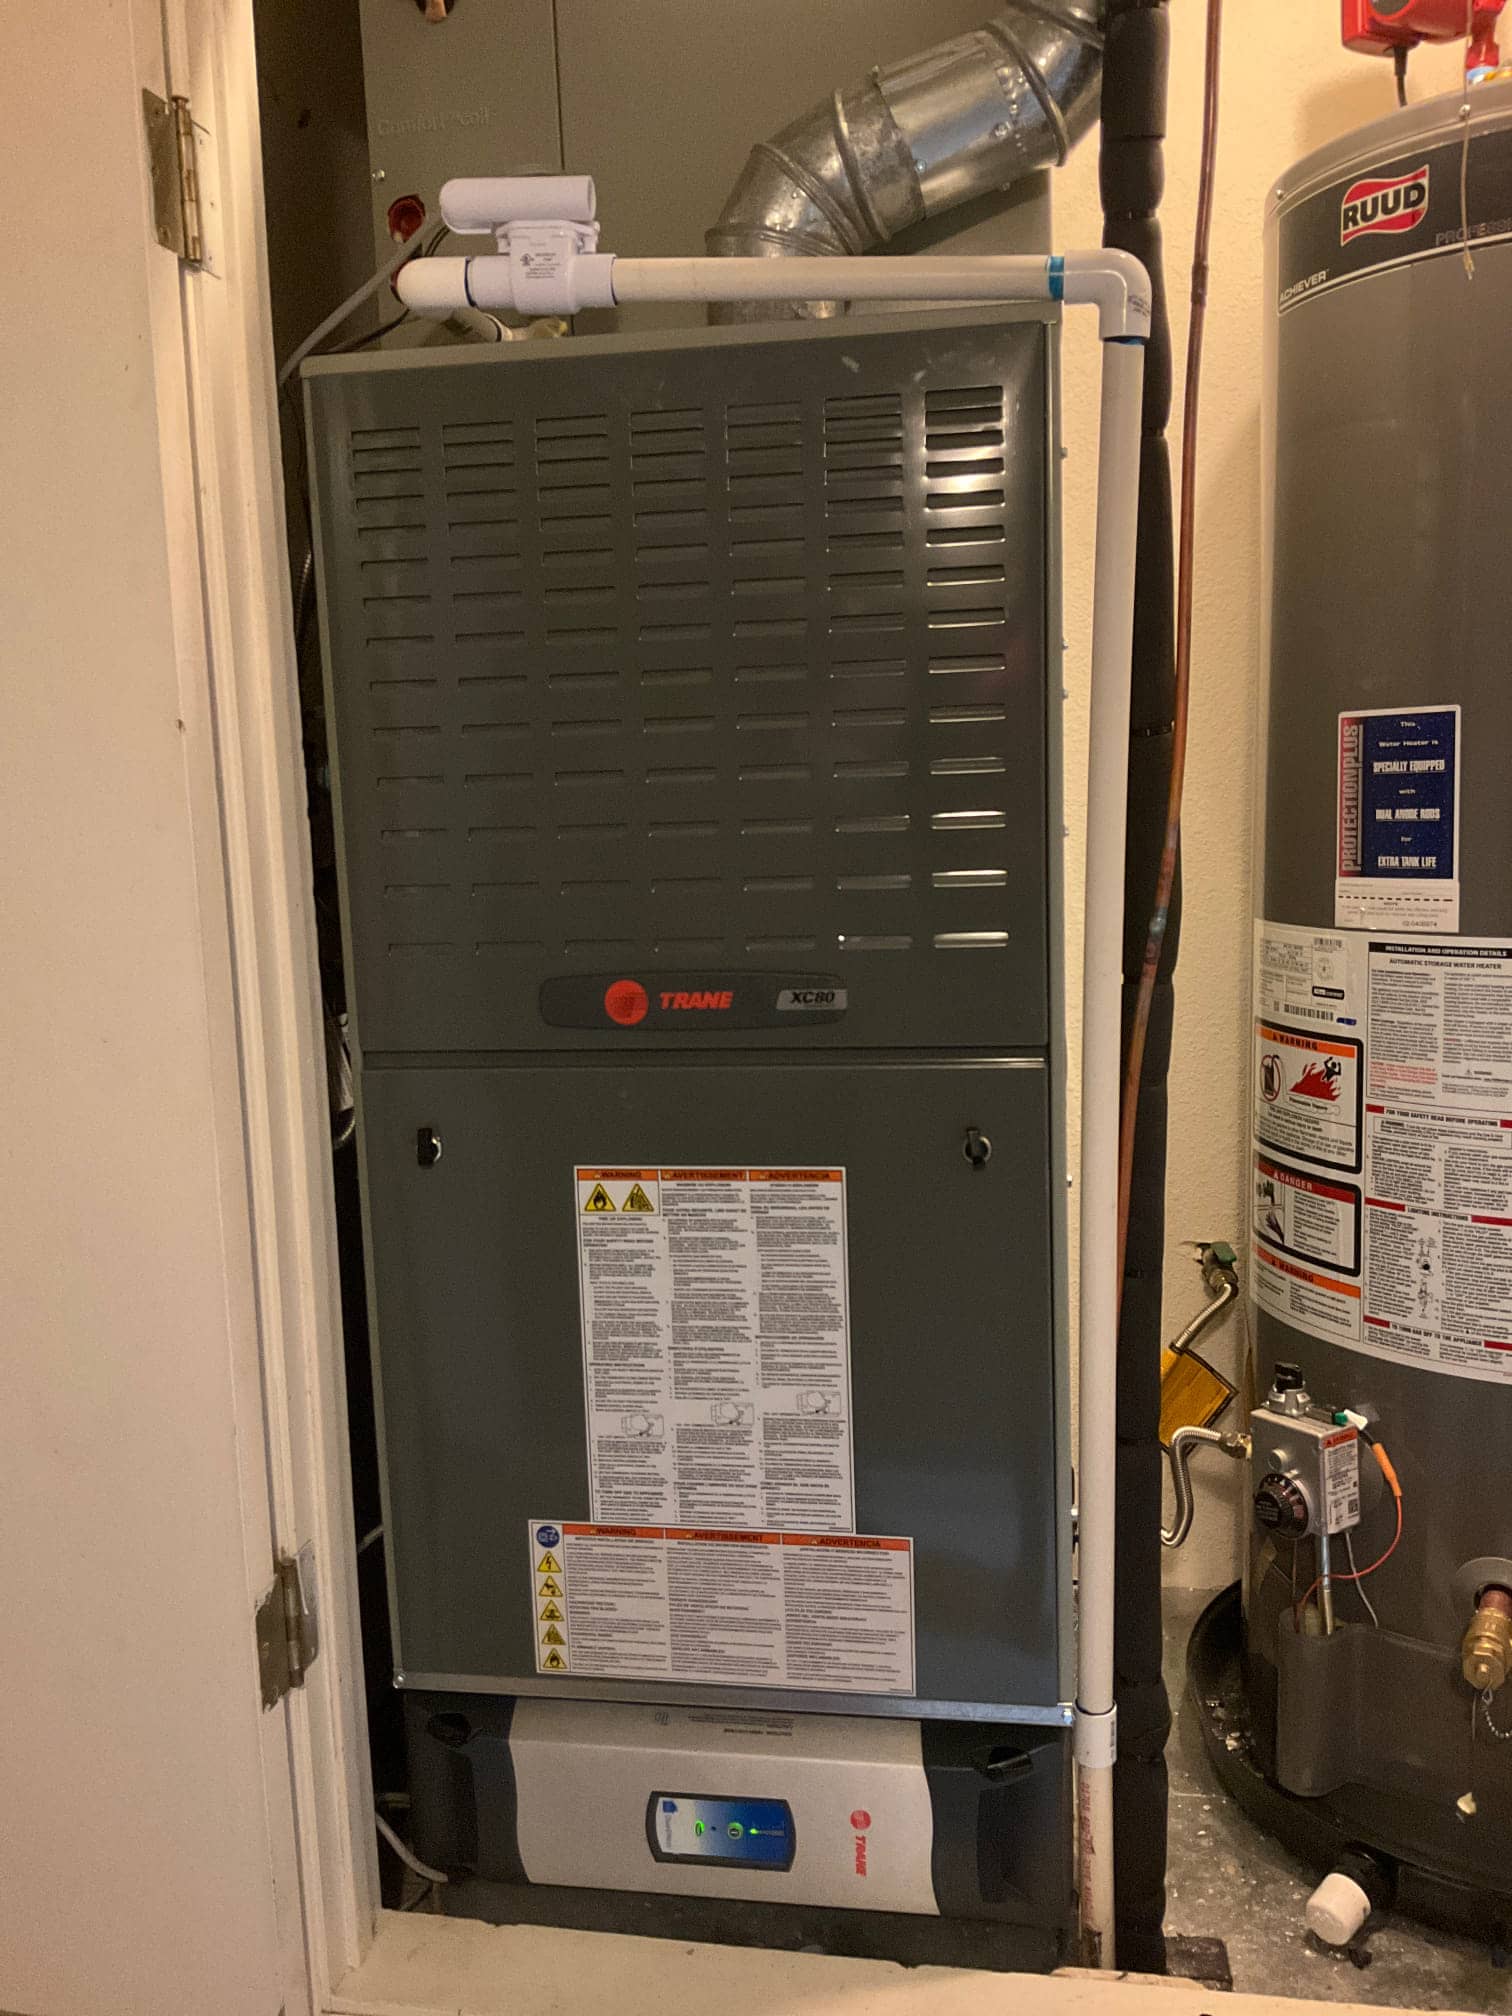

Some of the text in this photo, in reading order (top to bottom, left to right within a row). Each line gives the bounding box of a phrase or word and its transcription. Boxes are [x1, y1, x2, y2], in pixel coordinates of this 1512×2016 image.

[1342, 181, 1426, 232] RUUD
[1279, 269, 1328, 304] ACHIEVER
[1373, 759, 1445, 773] SPECIALLY EQUIPPED
[1378, 855, 1437, 868] EXTRA TANK LIFE
[1441, 947, 1479, 956] OPERATION
[1479, 949, 1507, 957] DETAILS
[1389, 958, 1502, 970] AUTOMATIC STORAGE WATER HEATER
[660, 991, 836, 1009] TRANE XC80
[1279, 1034, 1318, 1051] WARNING
[1280, 1173, 1313, 1192] DANGER
[1279, 1260, 1314, 1283] WARNING
[597, 1528, 637, 1536] WARNING
[694, 1533, 763, 1542] AVERTISSEMENT
[819, 1538, 881, 1547] ADVERTENCIA
[855, 1834, 867, 1878] TRANE
